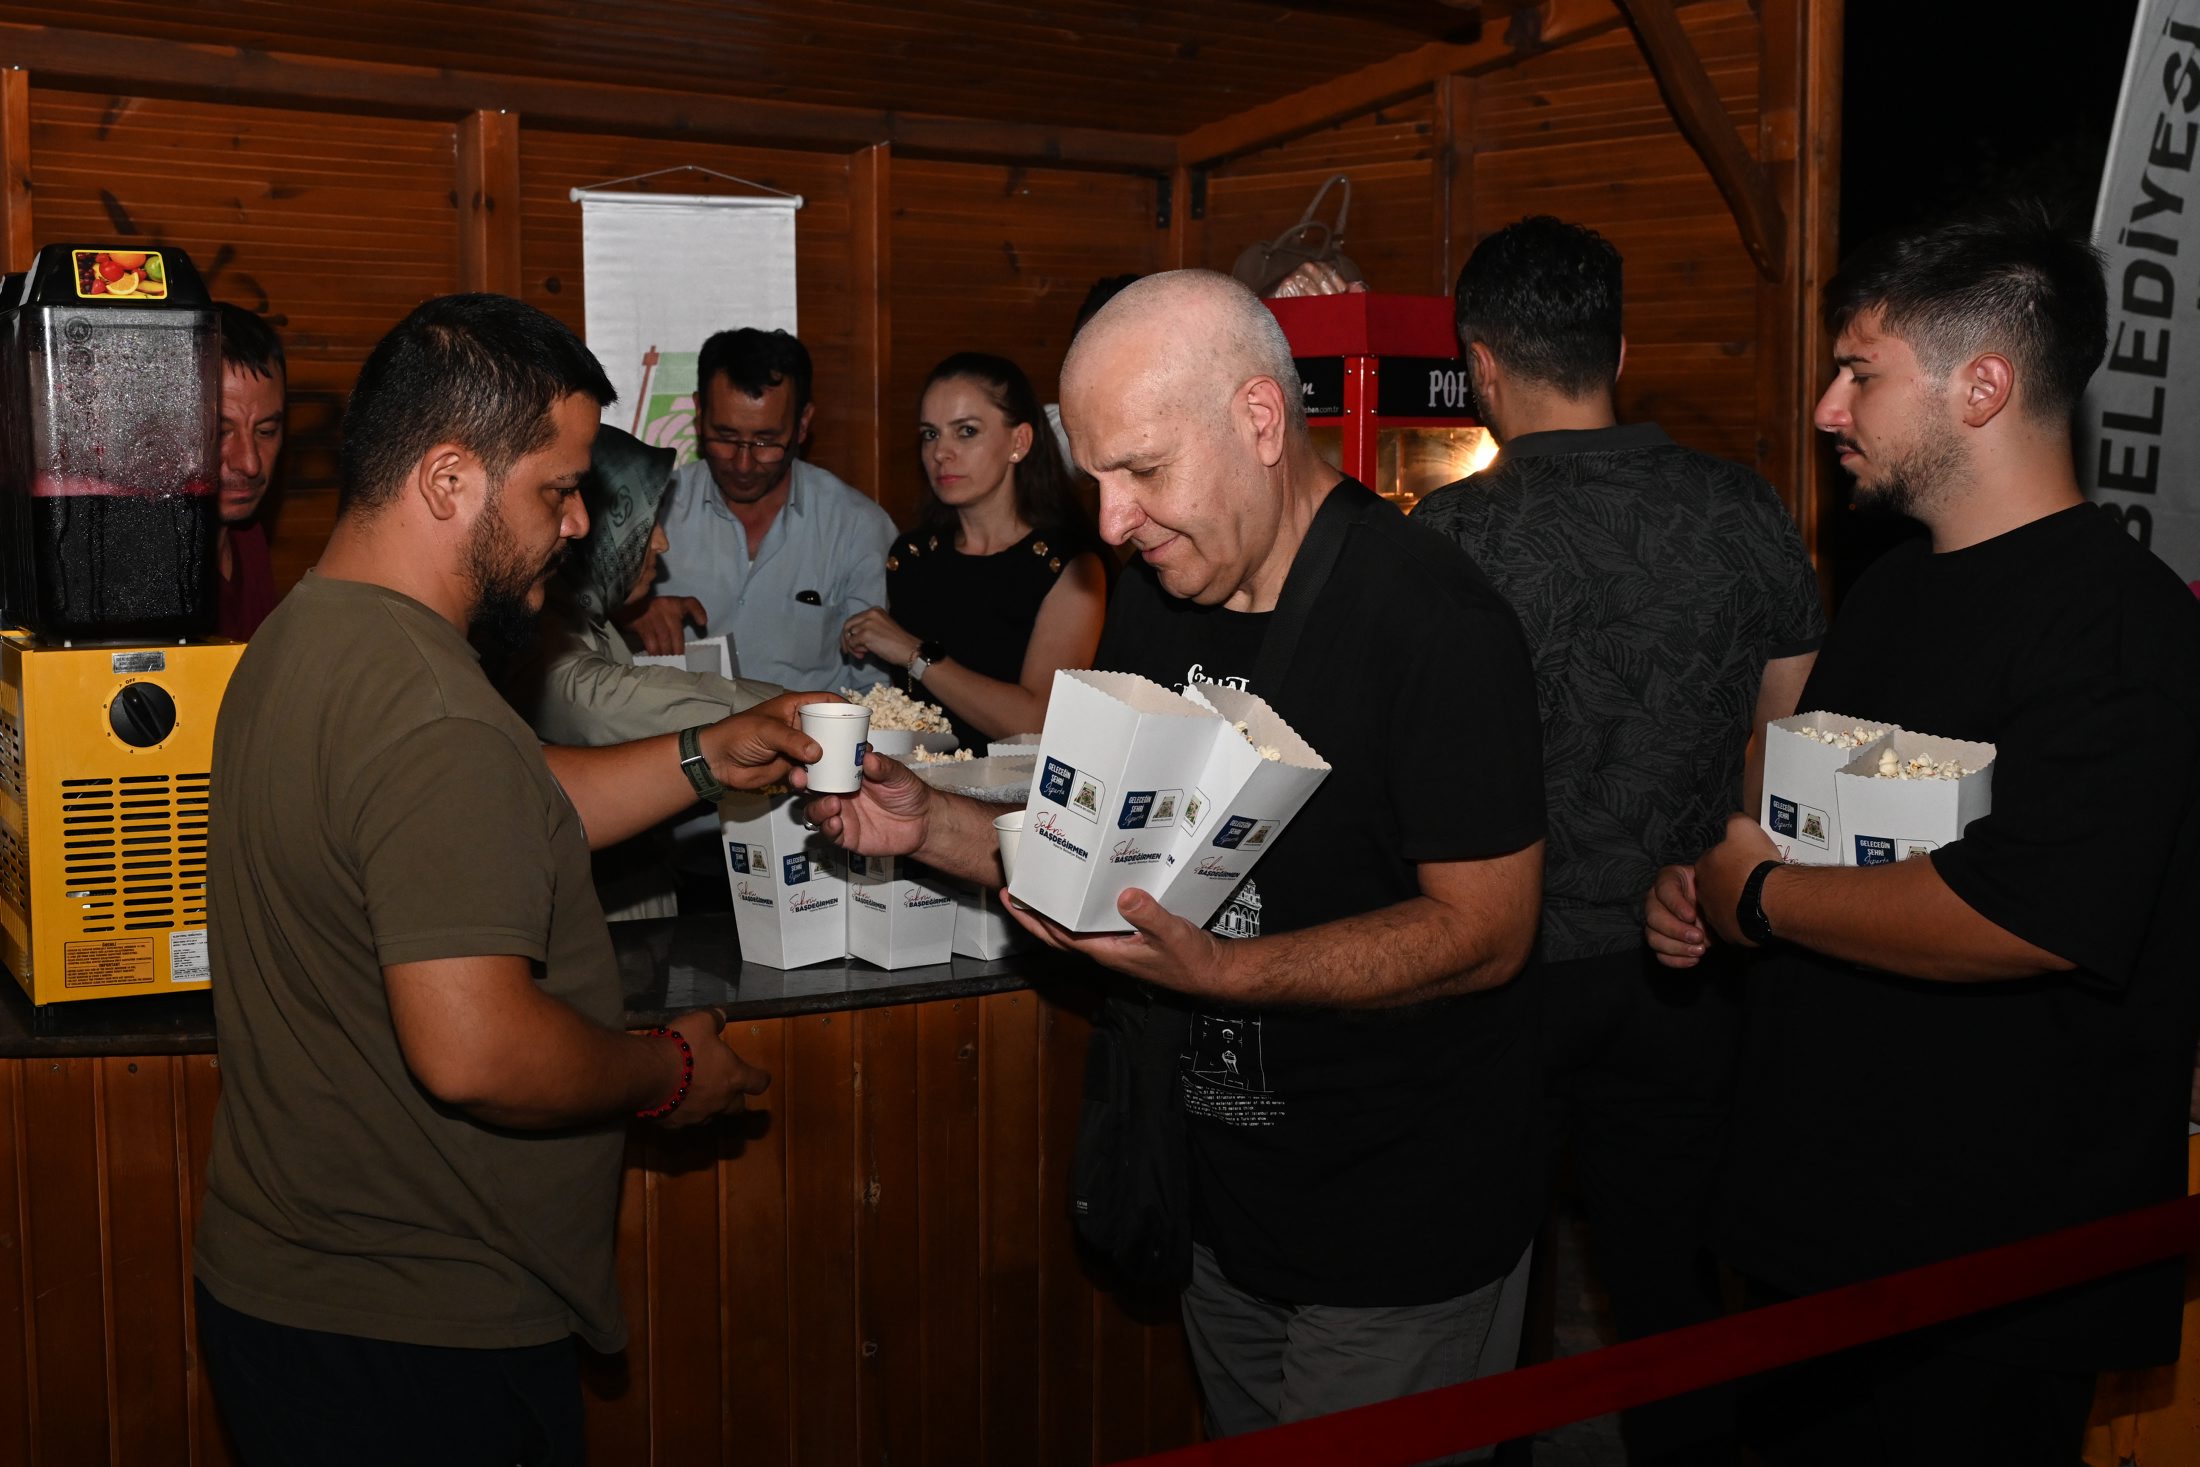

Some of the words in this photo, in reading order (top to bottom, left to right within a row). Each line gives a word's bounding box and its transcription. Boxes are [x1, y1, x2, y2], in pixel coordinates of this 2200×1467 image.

[125, 677, 136, 685] OFF
[1048, 762, 1071, 780] GELECEĞİN
[1039, 828, 1088, 858] BAŞDEĞİRMEN
[1860, 840, 1890, 849] GELECEĞİN
[1115, 853, 1161, 864] BAŞDEĞİRMEN
[1867, 849, 1884, 857] ŞEHRİ
[795, 898, 838, 912] BAŞDEĞİRMEN
[909, 897, 951, 908] BAŞDEĞİRMEN
